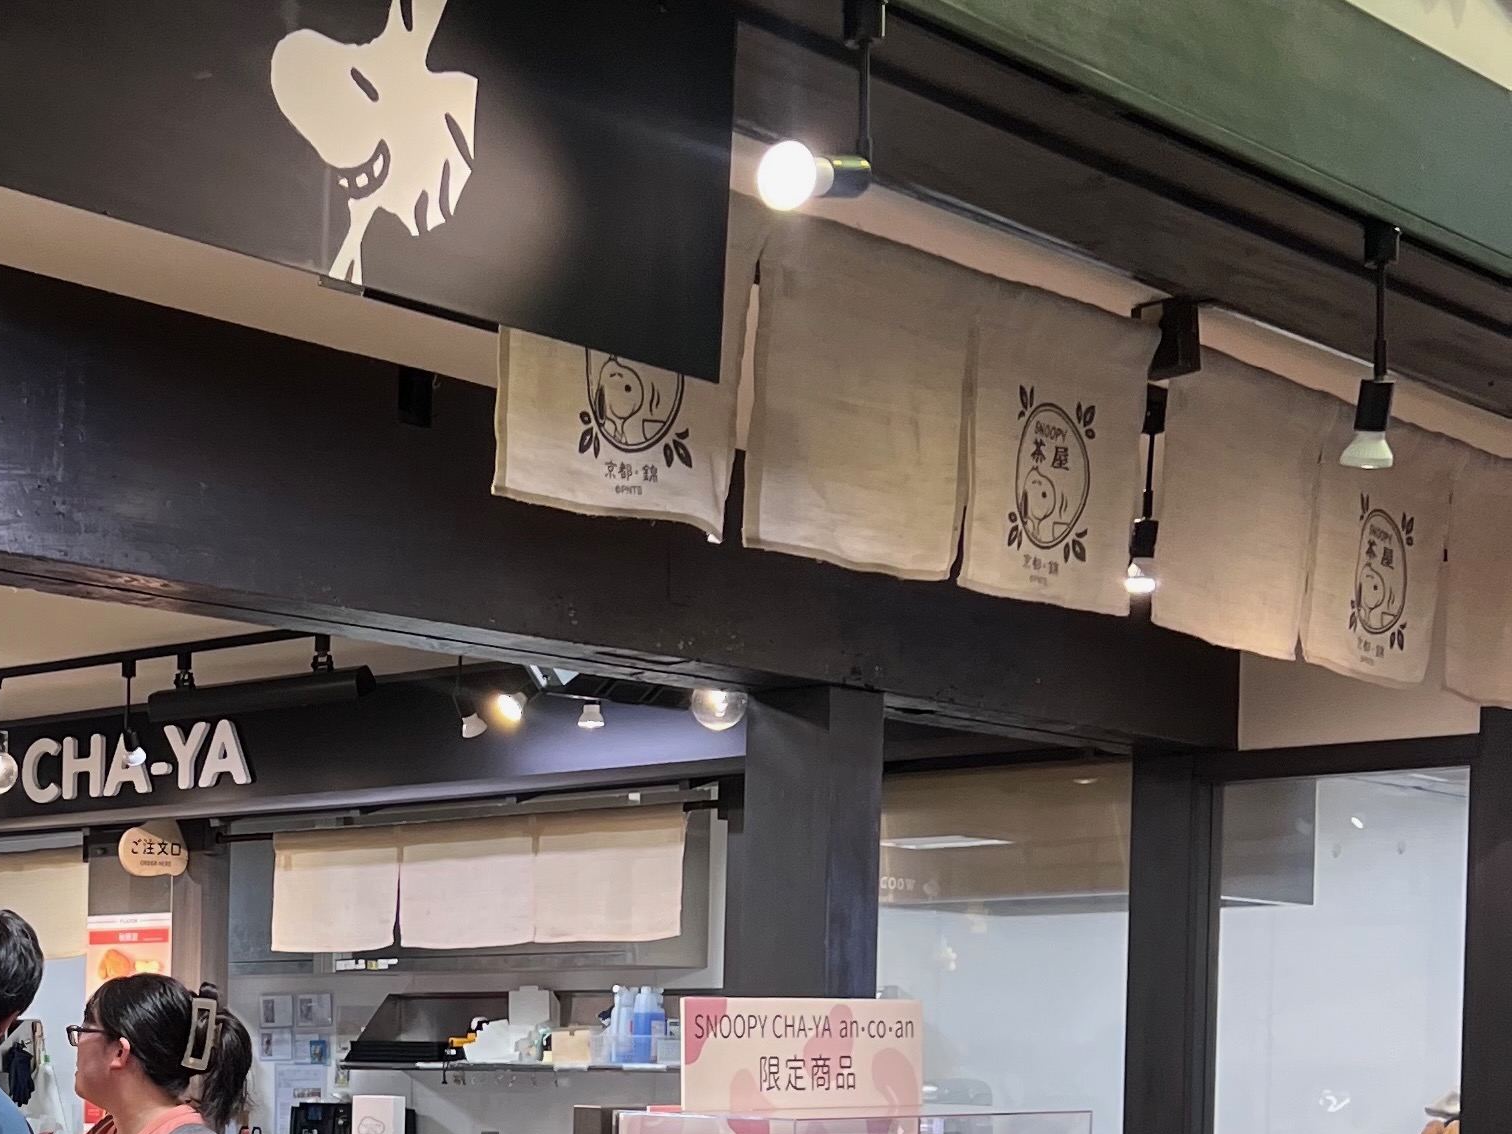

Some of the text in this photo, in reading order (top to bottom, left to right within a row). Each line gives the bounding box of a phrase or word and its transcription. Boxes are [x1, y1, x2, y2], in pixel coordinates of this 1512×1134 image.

[1034, 421, 1068, 444] SNOOPY
[1030, 438, 1069, 470] 茶屋
[21, 718, 252, 804] CHA-YA
[130, 838, 182, 856] ご注文口
[694, 1014, 768, 1039] SNOOPY
[772, 1014, 832, 1039] CHA-YA
[759, 1054, 856, 1092] 限定商品
